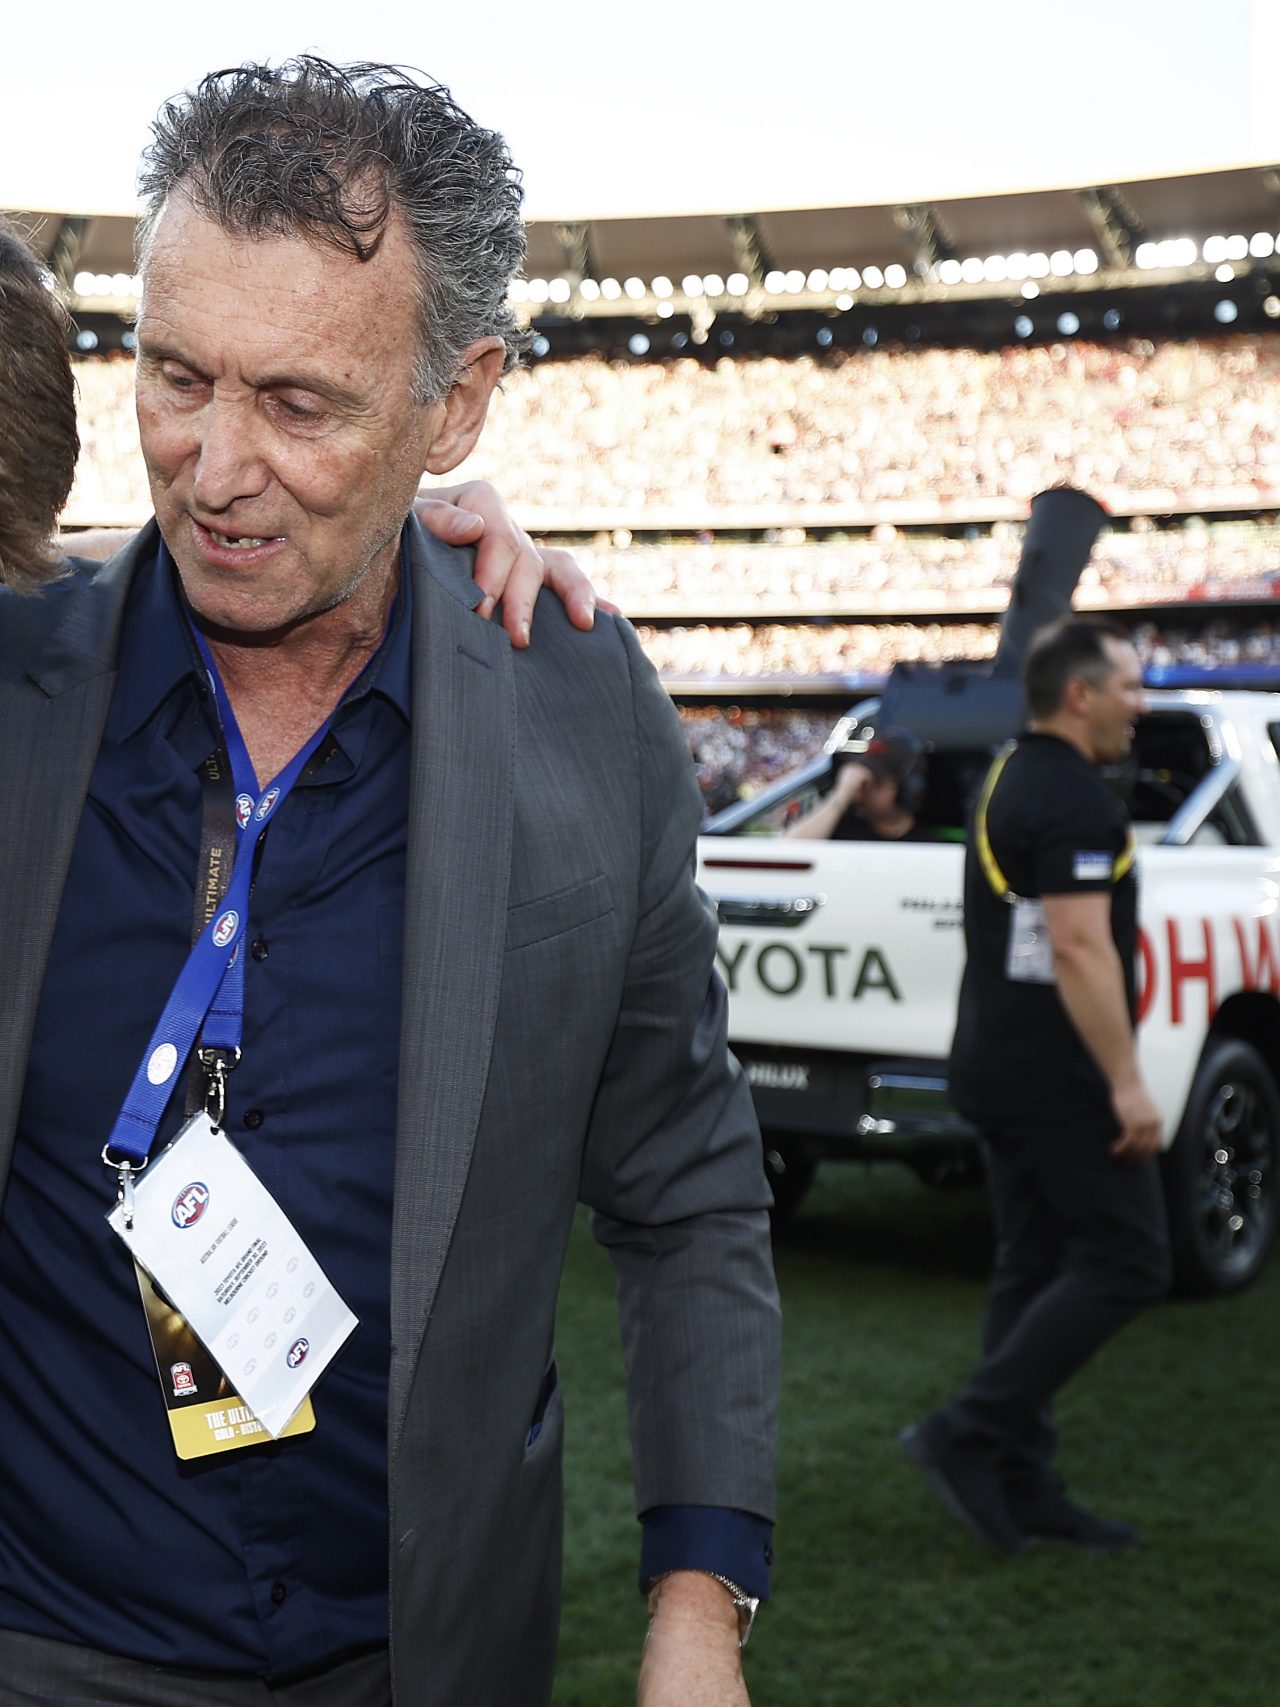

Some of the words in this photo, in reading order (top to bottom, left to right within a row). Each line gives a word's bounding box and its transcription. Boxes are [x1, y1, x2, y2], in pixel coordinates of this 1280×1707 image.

[717, 940, 904, 1003] YOTA
[176, 1187, 209, 1227] AFL
[223, 1267, 237, 1284] TOYOTA
[240, 1247, 253, 1263] GRAND
[251, 1237, 261, 1249] FINAL
[289, 1342, 309, 1366] AFL
[206, 1411, 227, 1429] THE
[228, 1406, 254, 1424] ULTI
